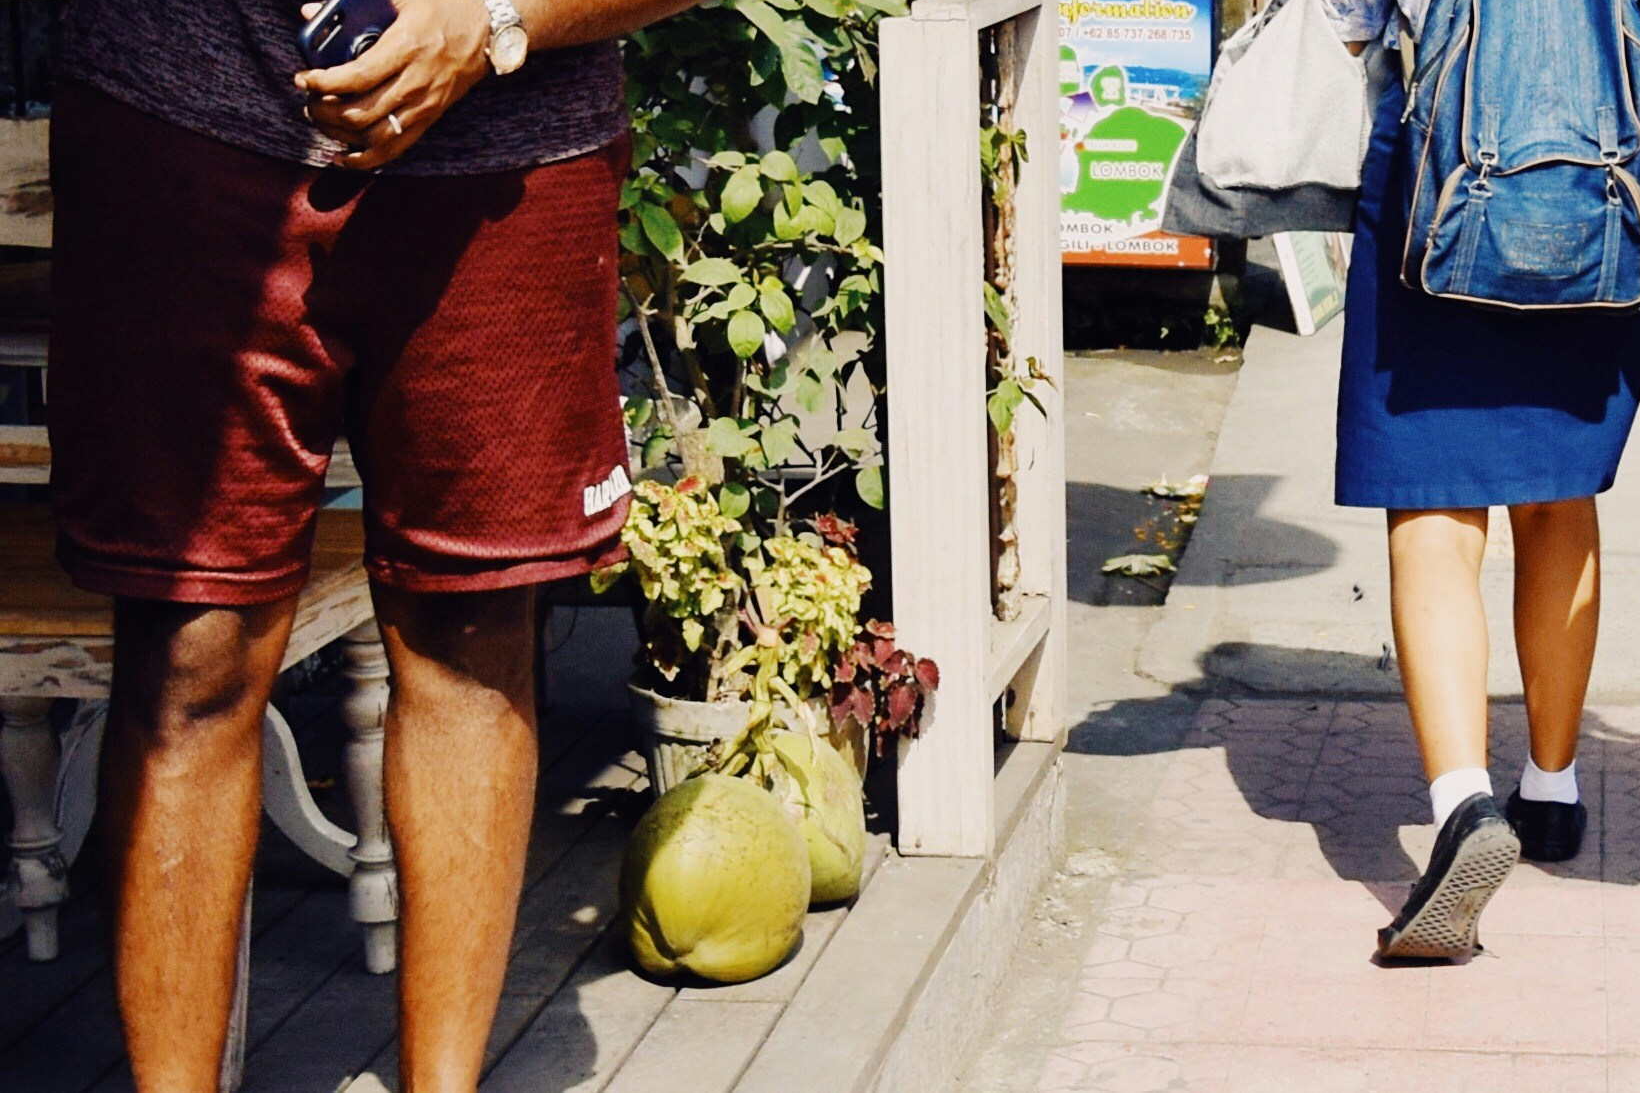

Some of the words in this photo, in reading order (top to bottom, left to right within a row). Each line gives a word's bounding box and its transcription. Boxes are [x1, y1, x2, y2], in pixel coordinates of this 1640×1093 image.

[1083, 27, 1103, 38] +62
[1106, 28, 1120, 39] 85
[1124, 28, 1143, 39] 737
[1148, 28, 1167, 40] 268
[1171, 29, 1192, 41] 735
[1092, 163, 1163, 178] LOMBOK
[1060, 239, 1090, 250] GILI
[1107, 240, 1176, 252] LOMBOK
